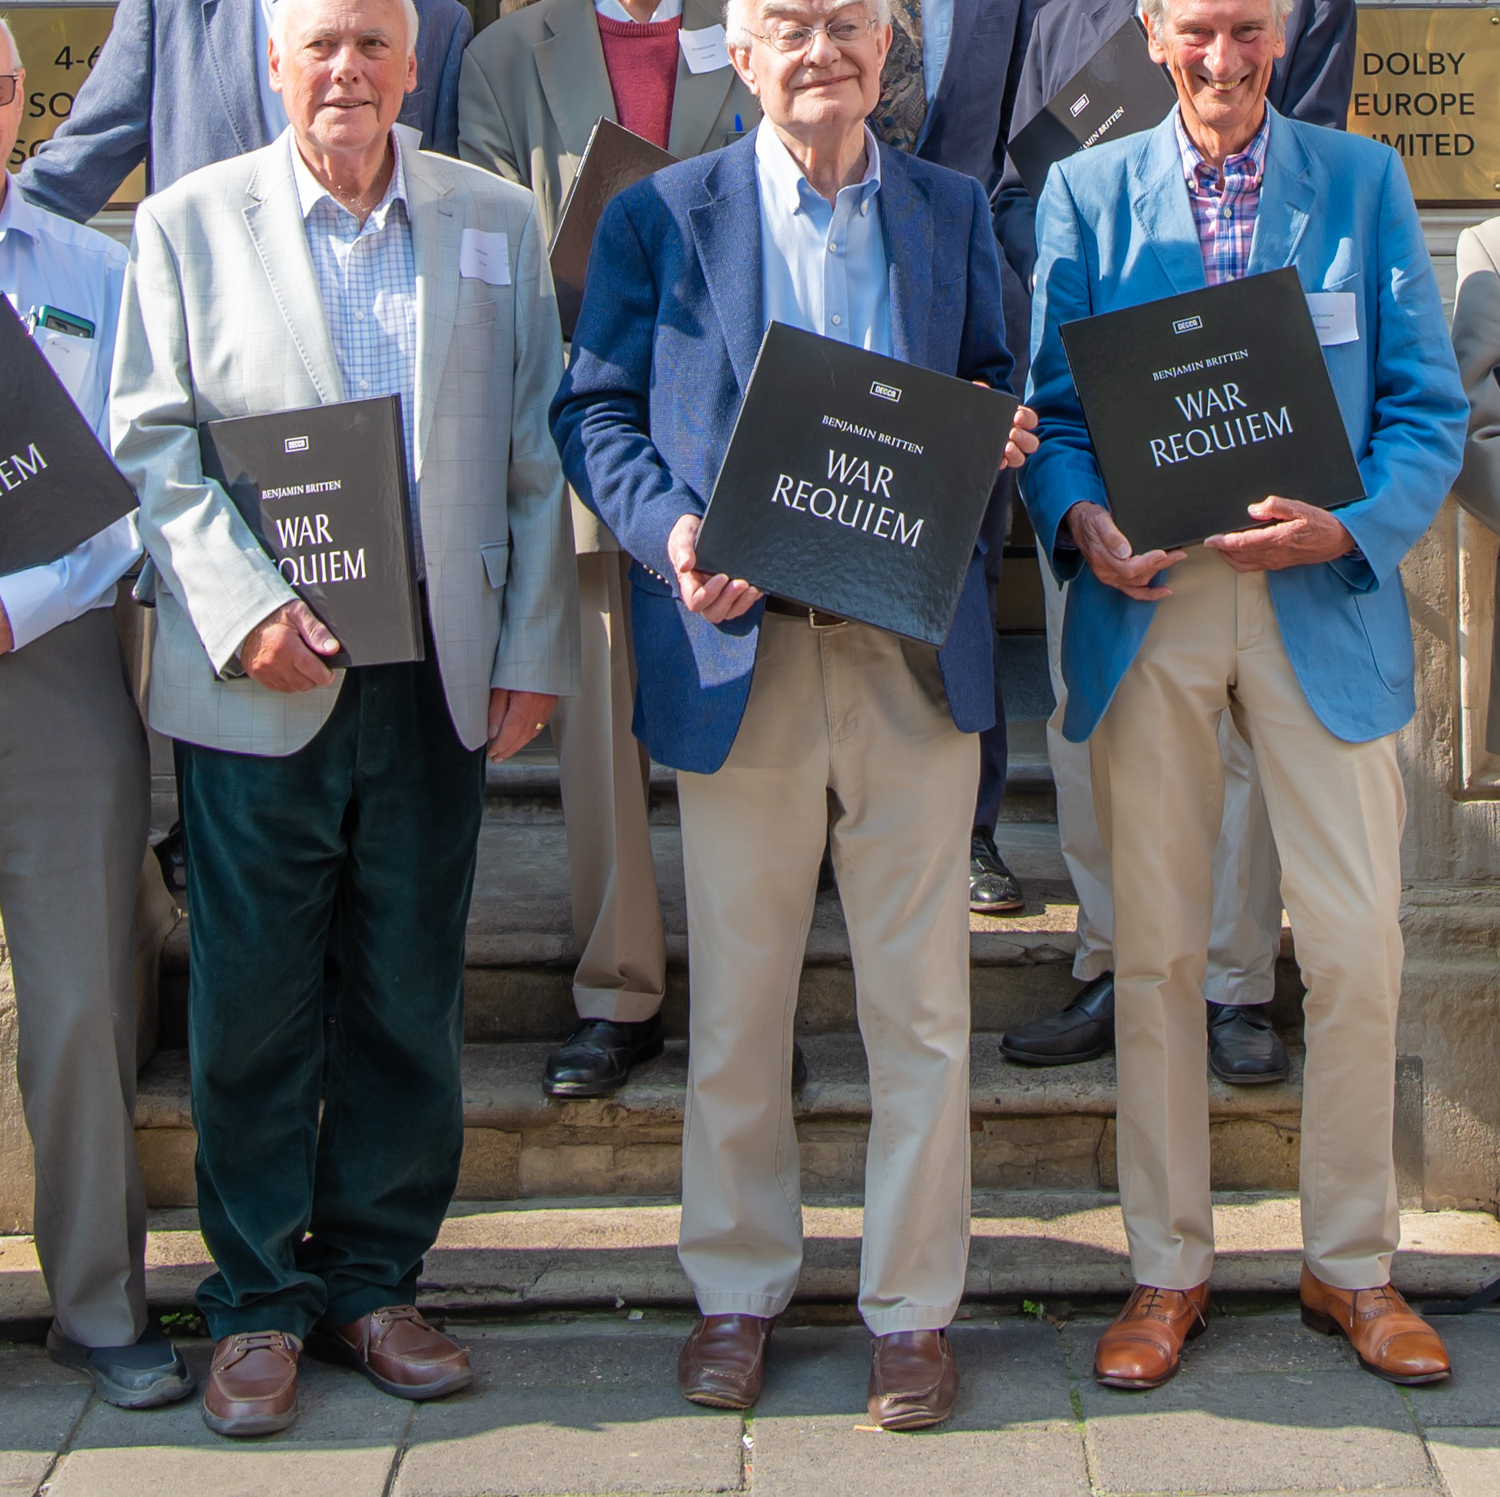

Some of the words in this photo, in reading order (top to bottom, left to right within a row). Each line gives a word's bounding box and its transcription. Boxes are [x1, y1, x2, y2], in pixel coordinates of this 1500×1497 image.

[1363, 52, 1466, 76] DOLBY
[28, 92, 74, 118] SO
[1097, 105, 1125, 135] BRITTEN
[1354, 92, 1475, 116] EUROPE
[1371, 134, 1475, 156] MITED
[1152, 360, 1204, 381] BENJAMIN
[1205, 349, 1249, 368] BRITTEN
[1174, 382, 1248, 422] WAR
[821, 414, 877, 440] BENJAMIN
[877, 432, 925, 455] BRITTEN
[1149, 406, 1294, 468] REQUIEM
[262, 484, 305, 500] BENJAMIN
[305, 479, 342, 494] BRITTEN
[827, 448, 894, 499] WAR
[771, 473, 925, 548] REQUIEM
[275, 513, 334, 549] WAR
[272, 548, 367, 587] QUIEM
